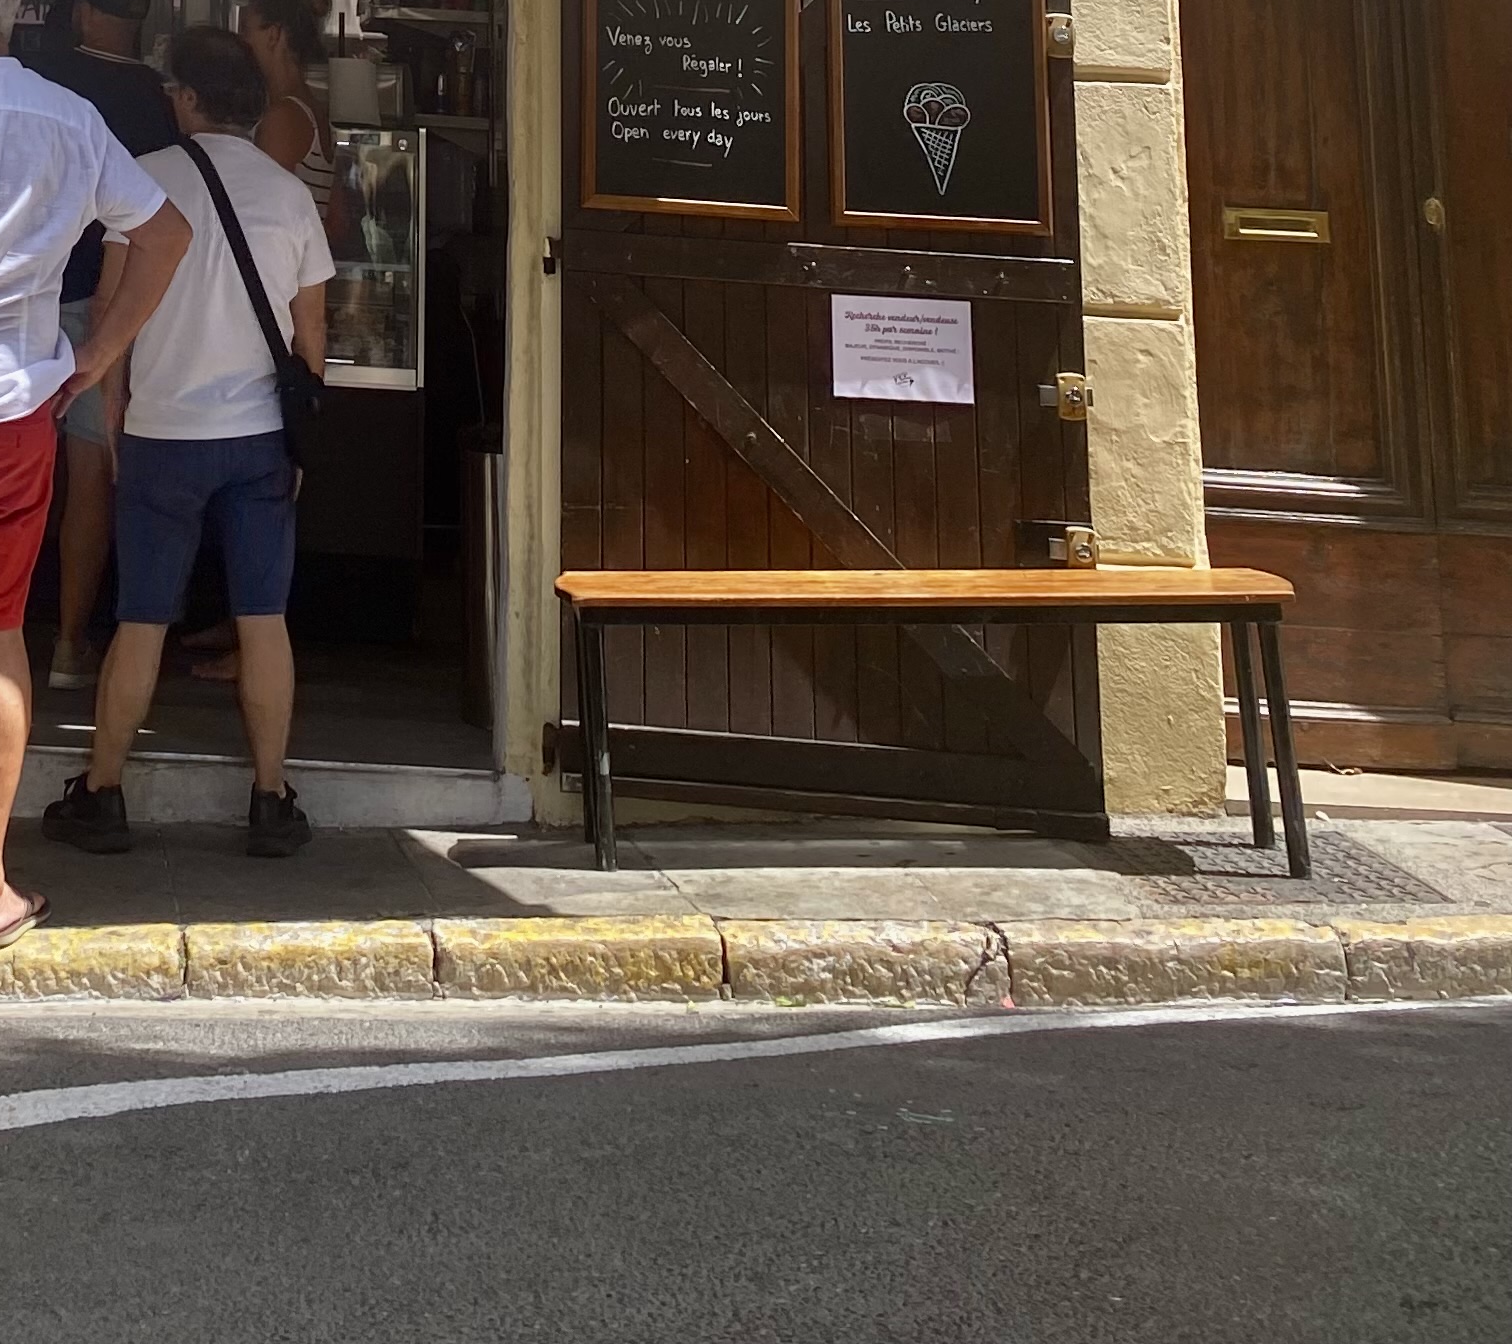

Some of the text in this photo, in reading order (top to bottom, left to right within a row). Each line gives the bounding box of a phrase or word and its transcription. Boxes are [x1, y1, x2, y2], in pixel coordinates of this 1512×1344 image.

[847, 10, 993, 33] Les Petits Glaciers
[606, 26, 692, 55] Venez vous
[682, 54, 732, 78] Régaler
[608, 96, 772, 127] Ouvert tous les jours
[611, 121, 734, 158] Open every day
